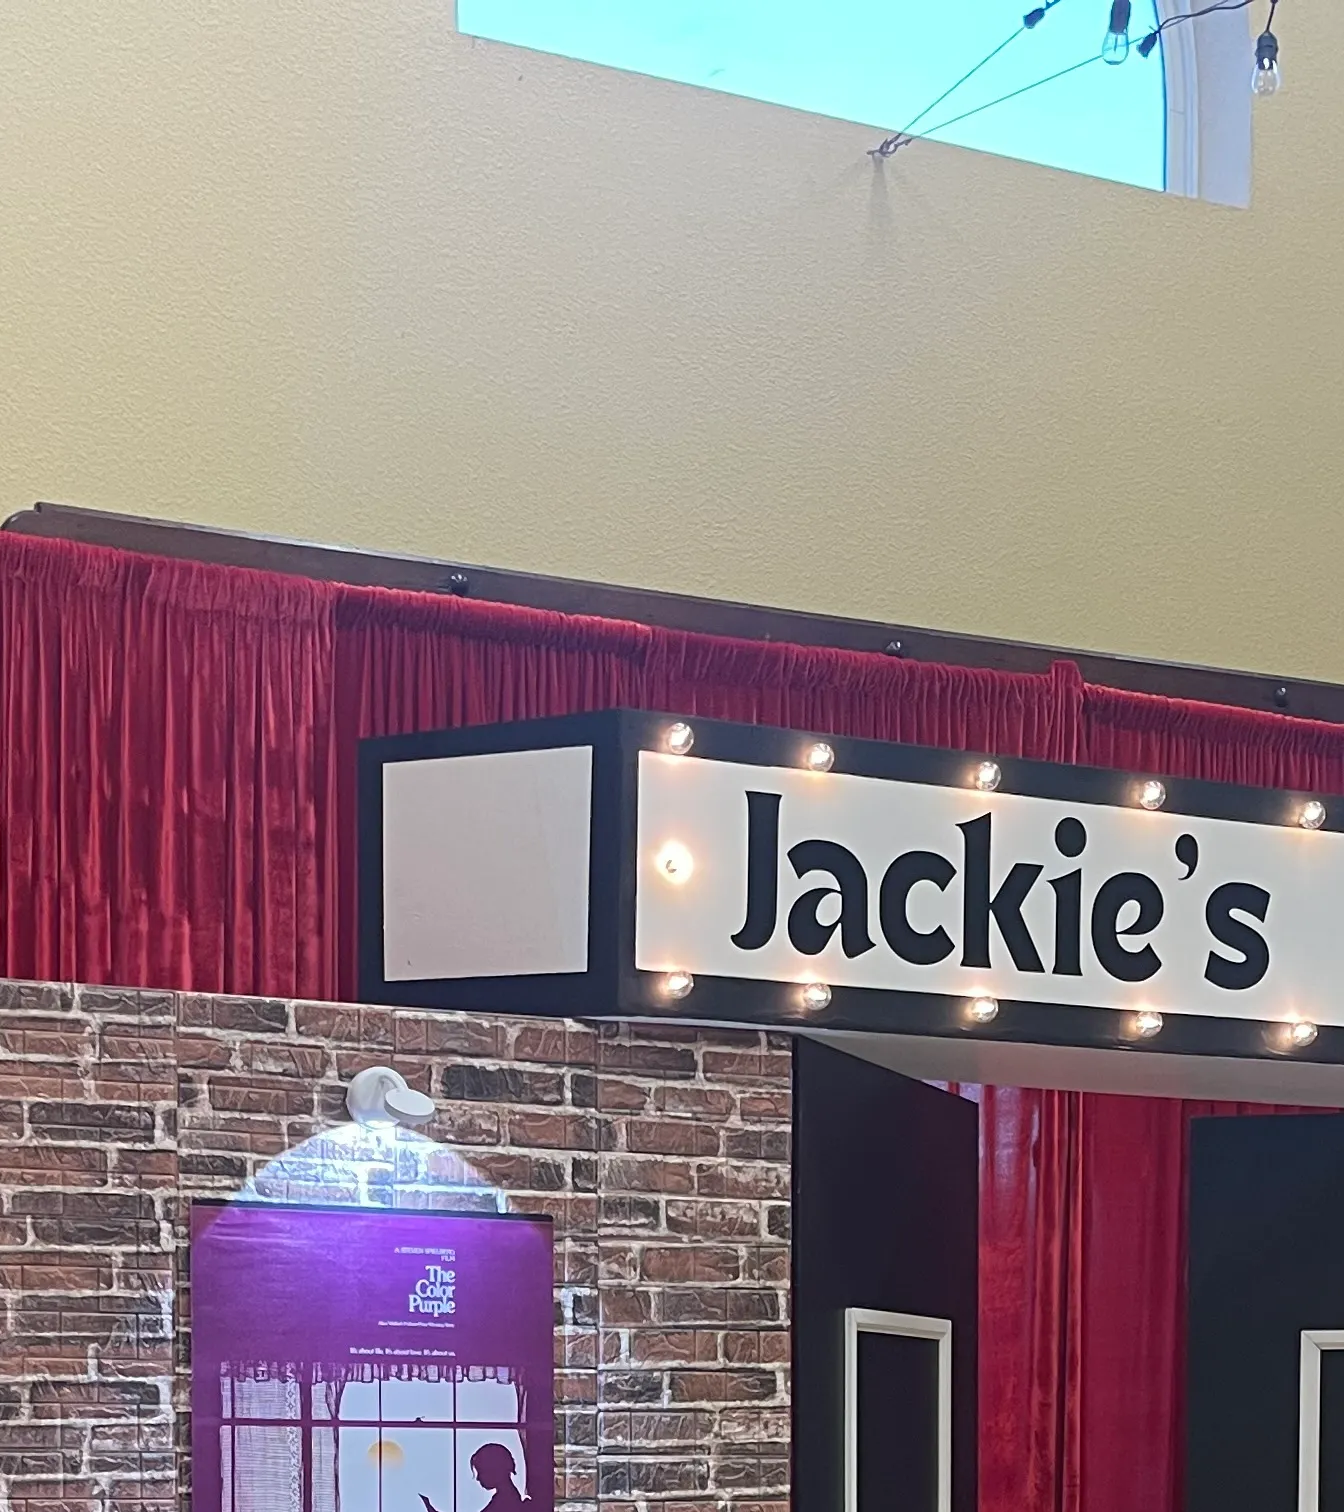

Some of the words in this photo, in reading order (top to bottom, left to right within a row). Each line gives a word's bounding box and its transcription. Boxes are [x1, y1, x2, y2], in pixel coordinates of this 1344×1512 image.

[730, 790, 1271, 991] Jackie's
[425, 1265, 456, 1282] The
[416, 1279, 456, 1298] Color
[409, 1295, 456, 1317] Purple
